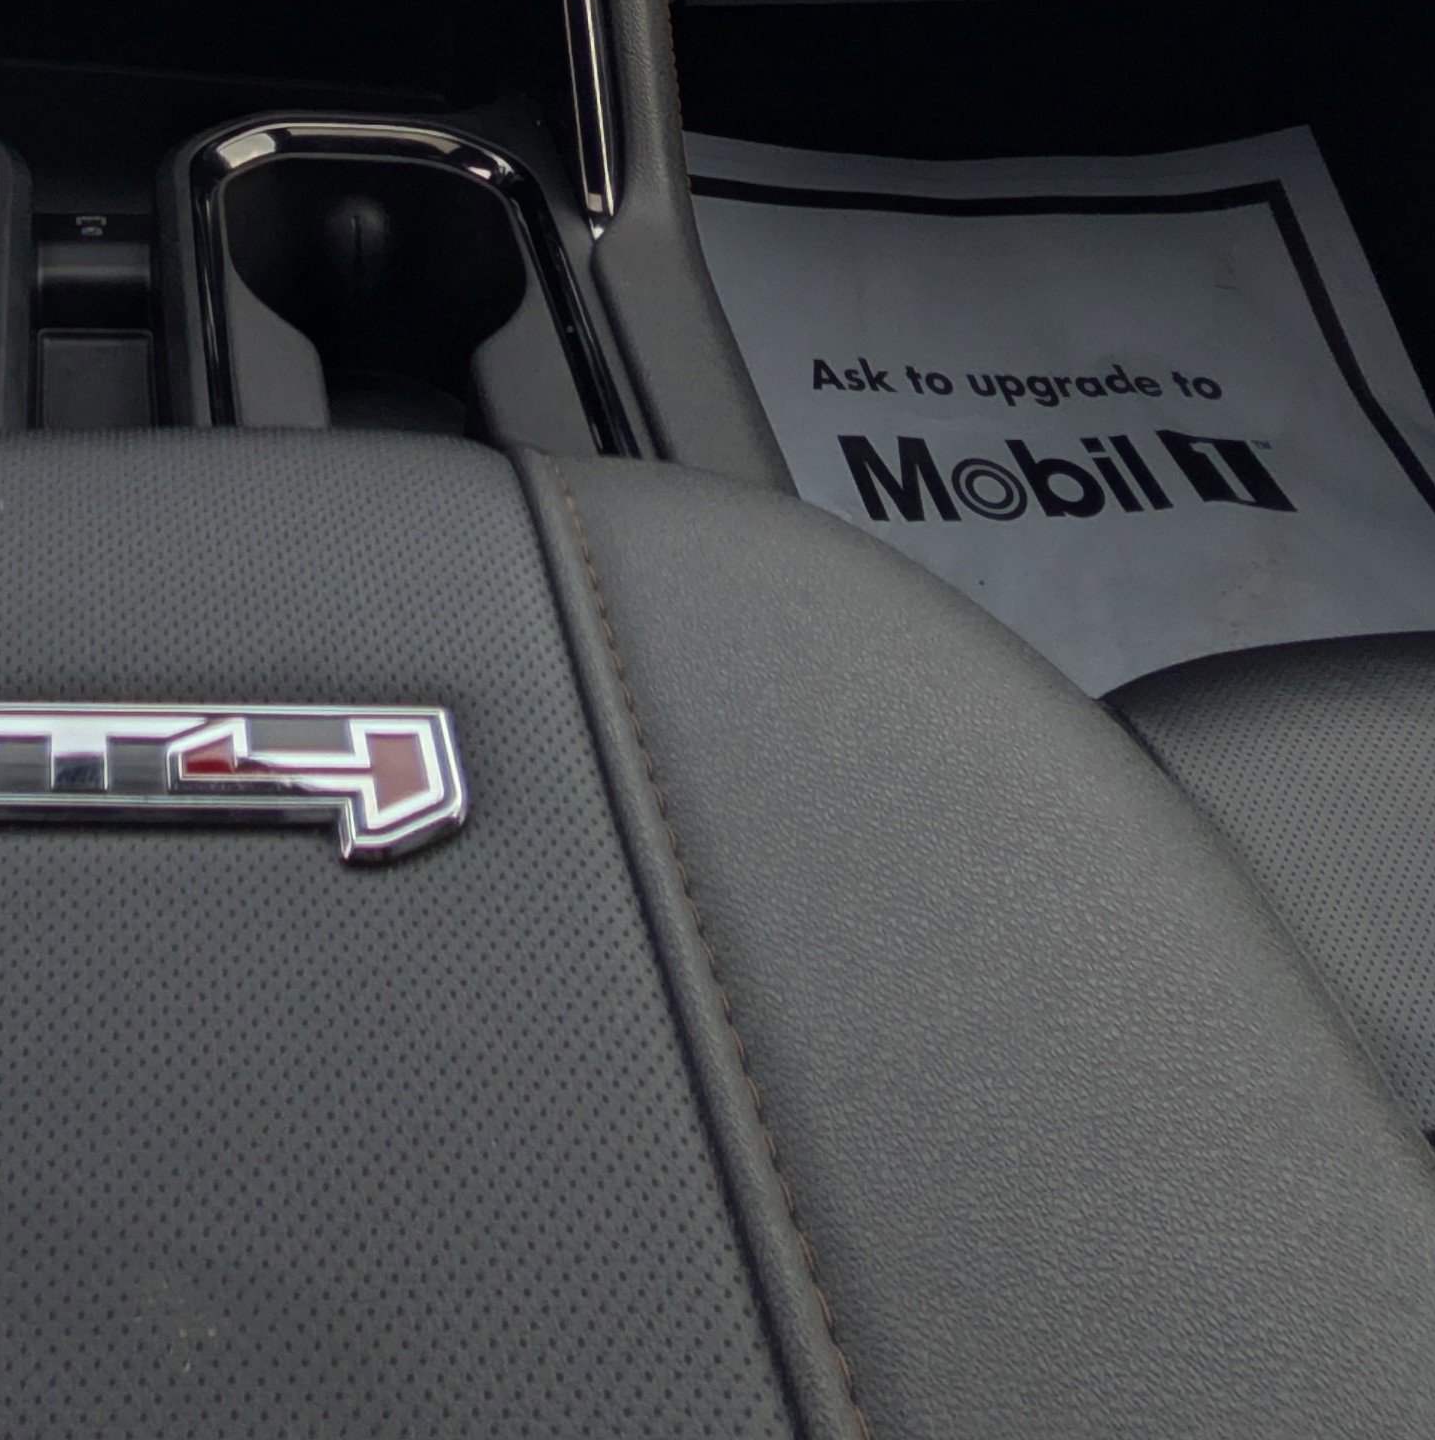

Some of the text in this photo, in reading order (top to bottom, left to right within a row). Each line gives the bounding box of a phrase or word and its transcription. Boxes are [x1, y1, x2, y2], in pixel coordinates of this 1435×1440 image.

[812, 358, 1223, 408] Ask to upgrade to
[836, 434, 1174, 522] Mobil
